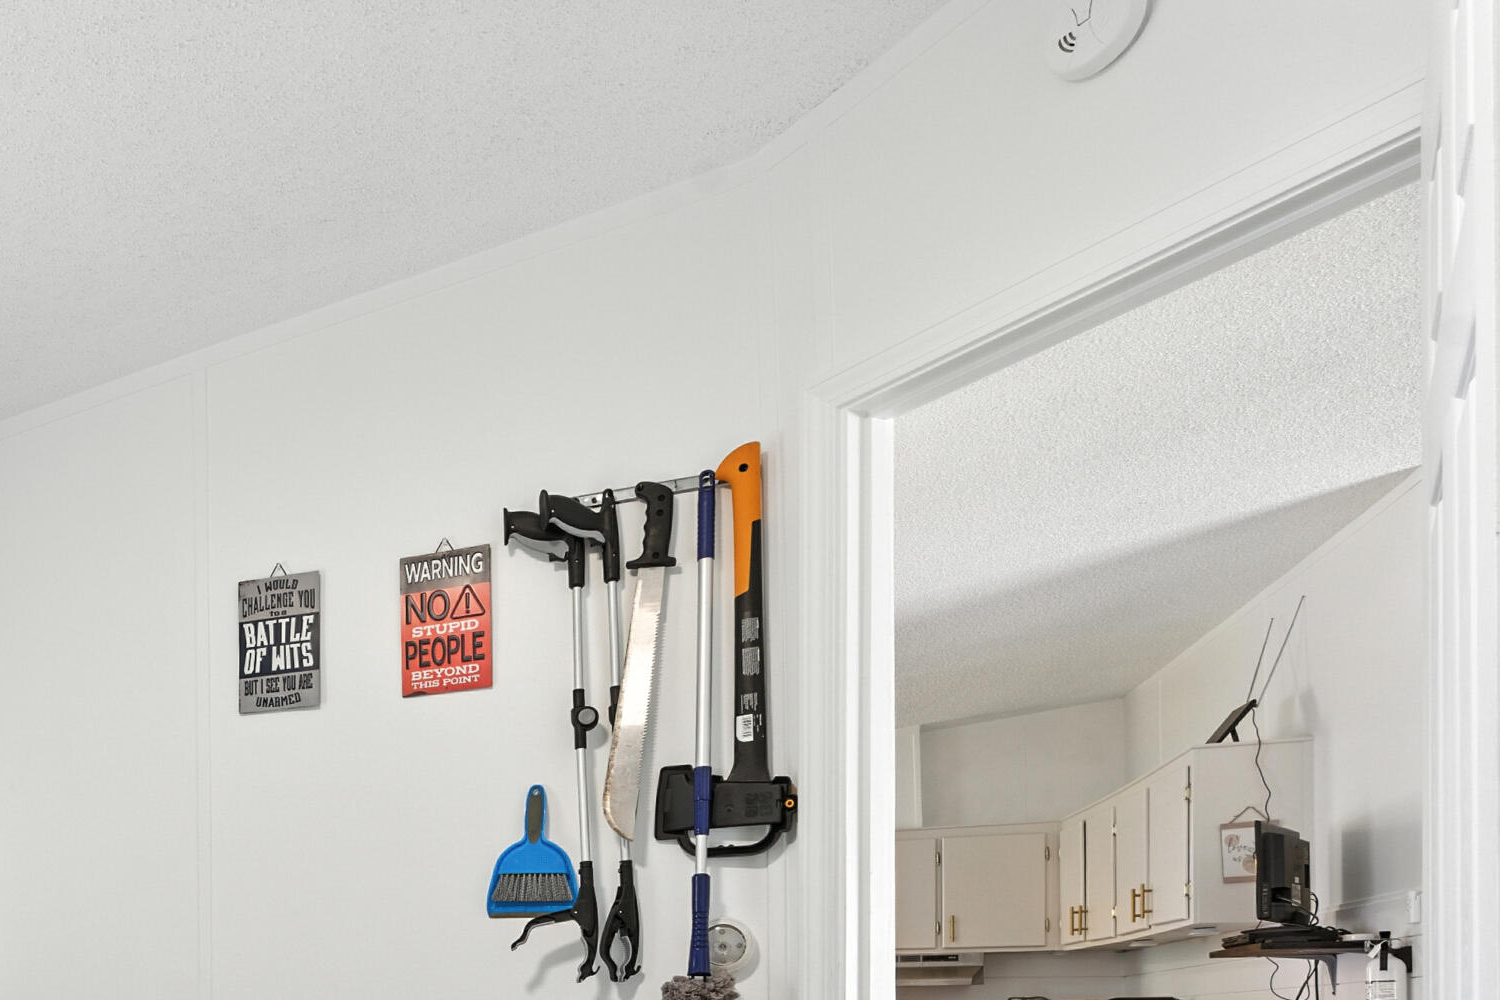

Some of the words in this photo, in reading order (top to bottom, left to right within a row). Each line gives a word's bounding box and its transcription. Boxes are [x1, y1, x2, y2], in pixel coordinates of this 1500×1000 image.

[404, 552, 484, 584] WARNING
[257, 585, 262, 595] I
[264, 578, 299, 593] WOULD
[242, 591, 294, 618] CHALLENGE
[298, 588, 316, 609] YOU
[405, 590, 450, 625] NO
[243, 614, 315, 649] BATTLE
[411, 618, 480, 638] STUPID
[243, 647, 267, 675] OF
[271, 642, 314, 672] WITS
[405, 631, 485, 670] PEOPLE
[244, 679, 259, 696] BUT
[260, 678, 264, 694] I
[265, 677, 280, 694] SEE
[282, 675, 296, 692] YOU
[298, 672, 313, 690] ARE
[411, 663, 480, 681] BEYOND
[411, 678, 440, 690] THIS
[443, 674, 480, 687] POINT
[255, 692, 301, 708] UNARMED
